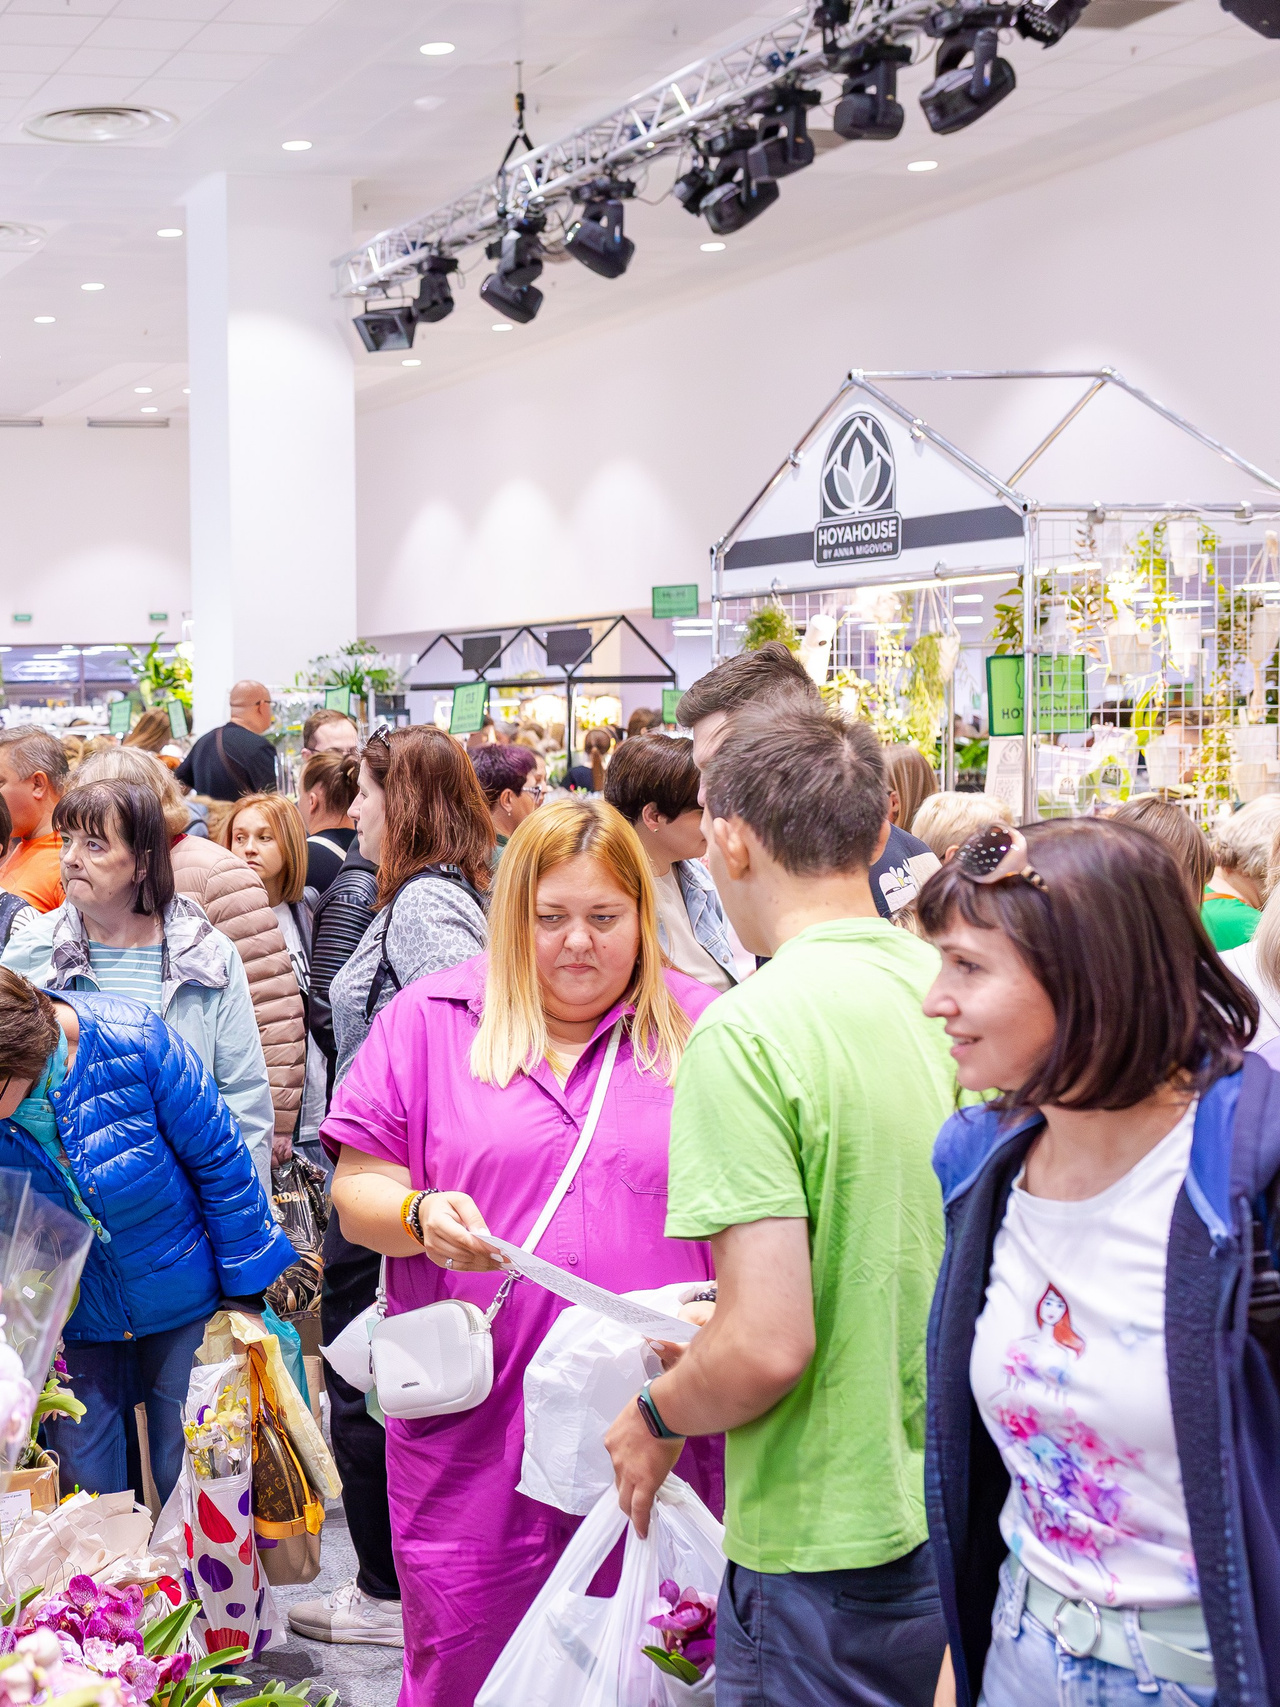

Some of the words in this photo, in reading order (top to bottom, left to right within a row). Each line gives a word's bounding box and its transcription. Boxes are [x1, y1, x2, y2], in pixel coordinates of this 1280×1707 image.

[818, 519, 897, 546] HOYAHOUSE
[822, 549, 833, 560] BY
[833, 546, 855, 558] ANNA
[855, 541, 893, 556] MIGOVICH
